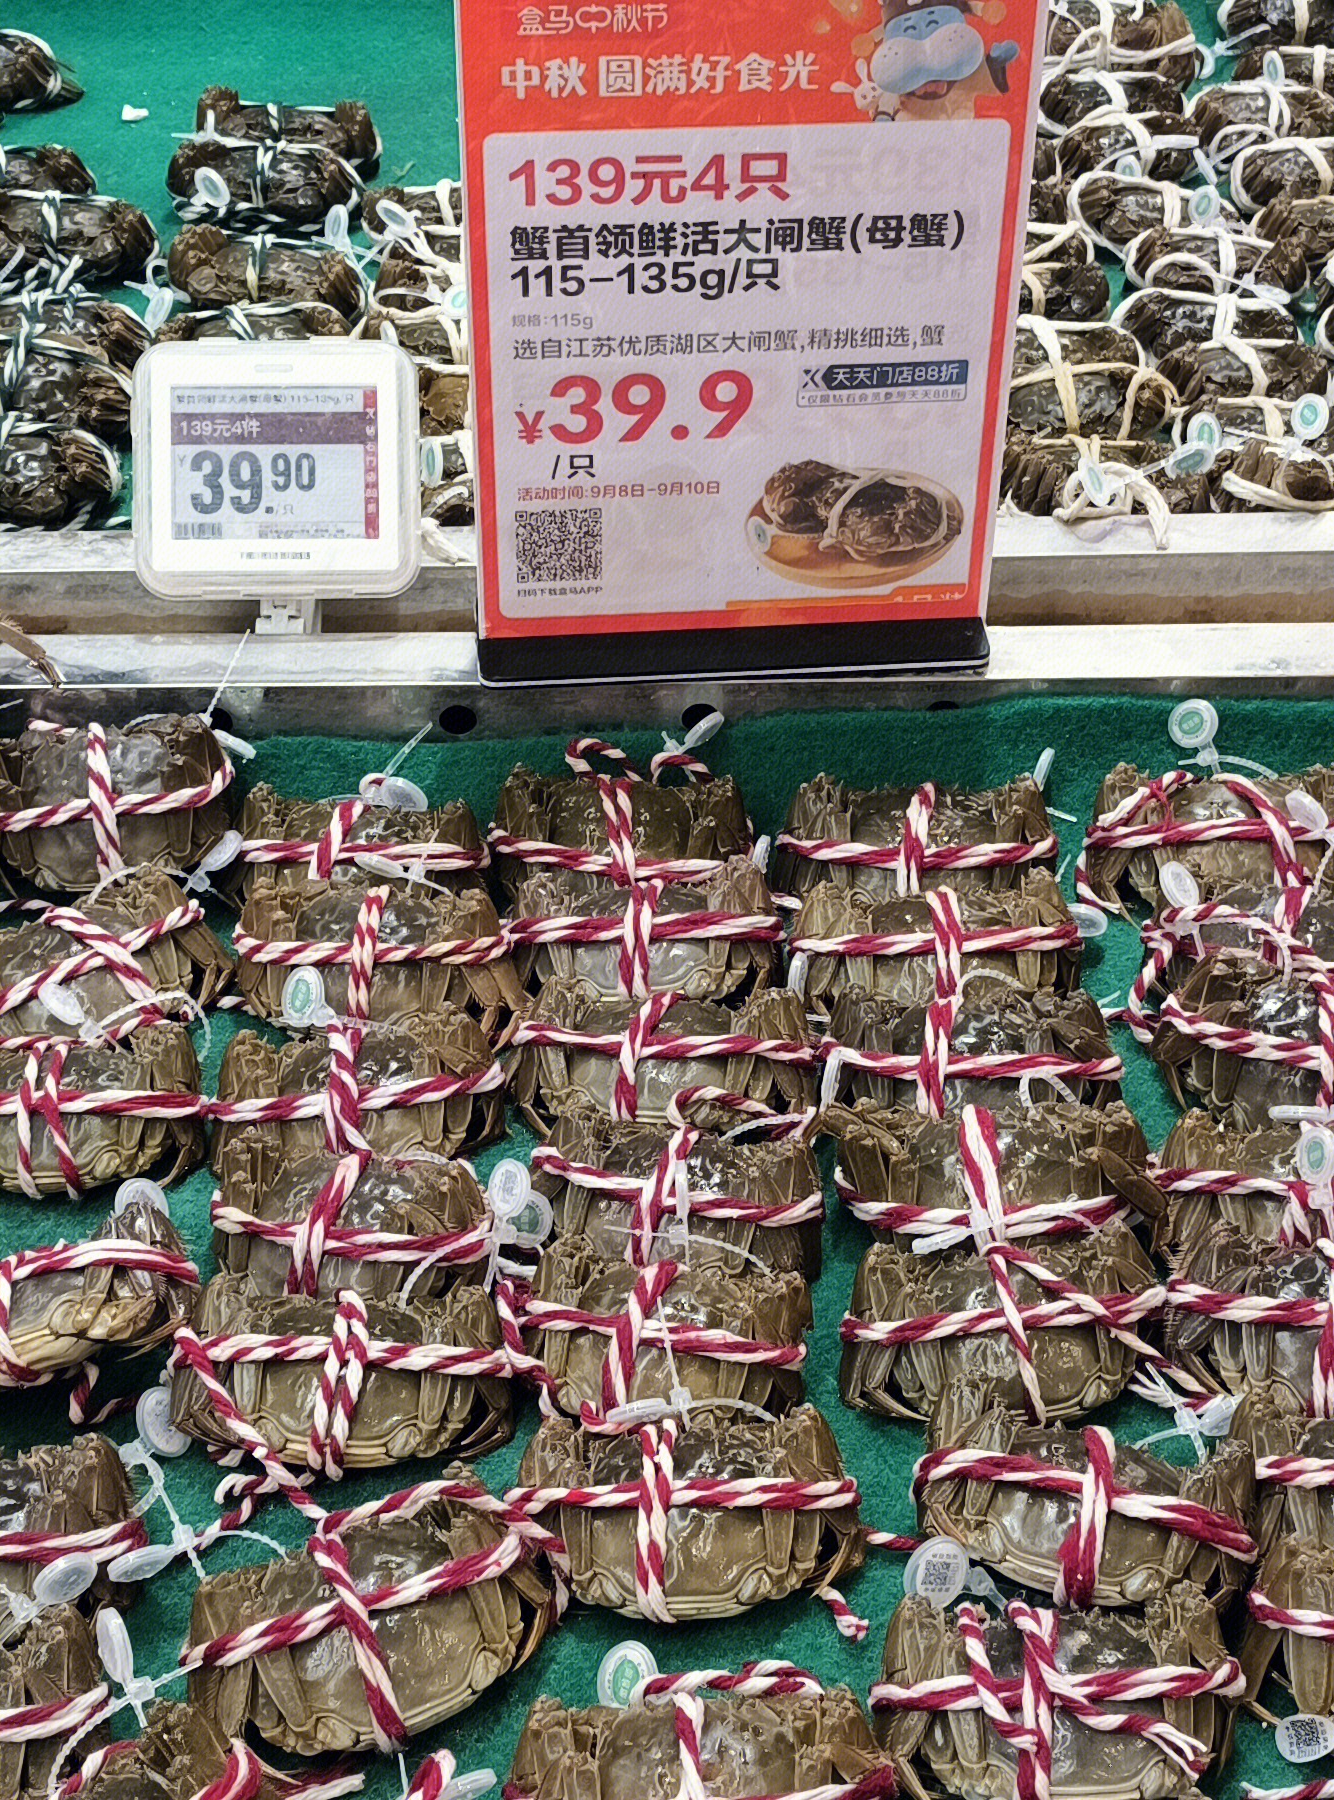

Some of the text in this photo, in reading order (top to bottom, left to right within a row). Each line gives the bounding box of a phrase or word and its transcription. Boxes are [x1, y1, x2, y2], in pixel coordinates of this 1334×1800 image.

[501, 49, 820, 100] 中秋 圆满好食光
[508, 151, 791, 208] 139元4只
[509, 209, 966, 263] 蟹首领鲜活大闸蟹(母蟹)
[830, 363, 961, 387] 天天门店88折
[180, 417, 262, 438] 139元4件
